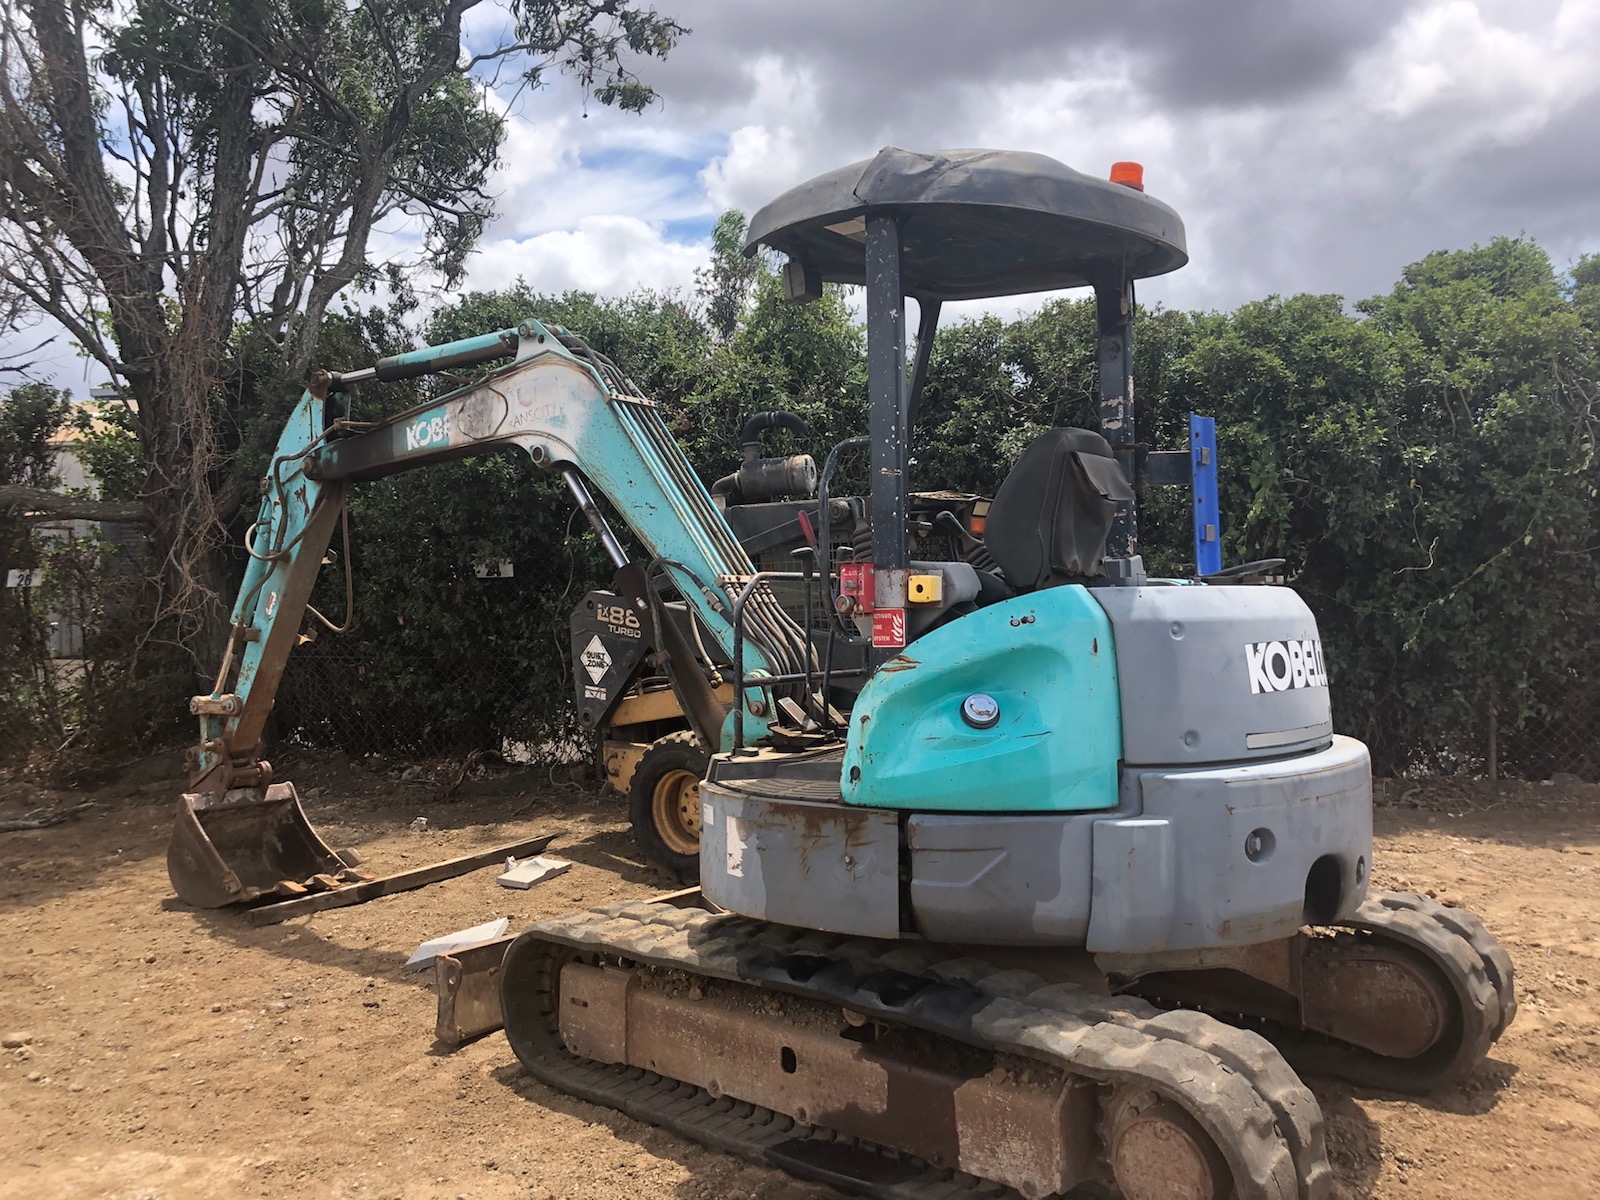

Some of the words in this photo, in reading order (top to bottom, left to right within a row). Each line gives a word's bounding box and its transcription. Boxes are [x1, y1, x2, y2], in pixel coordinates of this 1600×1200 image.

[17, 574, 32, 587] 26
[608, 624, 641, 638] TURBO
[586, 651, 606, 660] QUIET
[587, 660, 606, 669] ZONE
